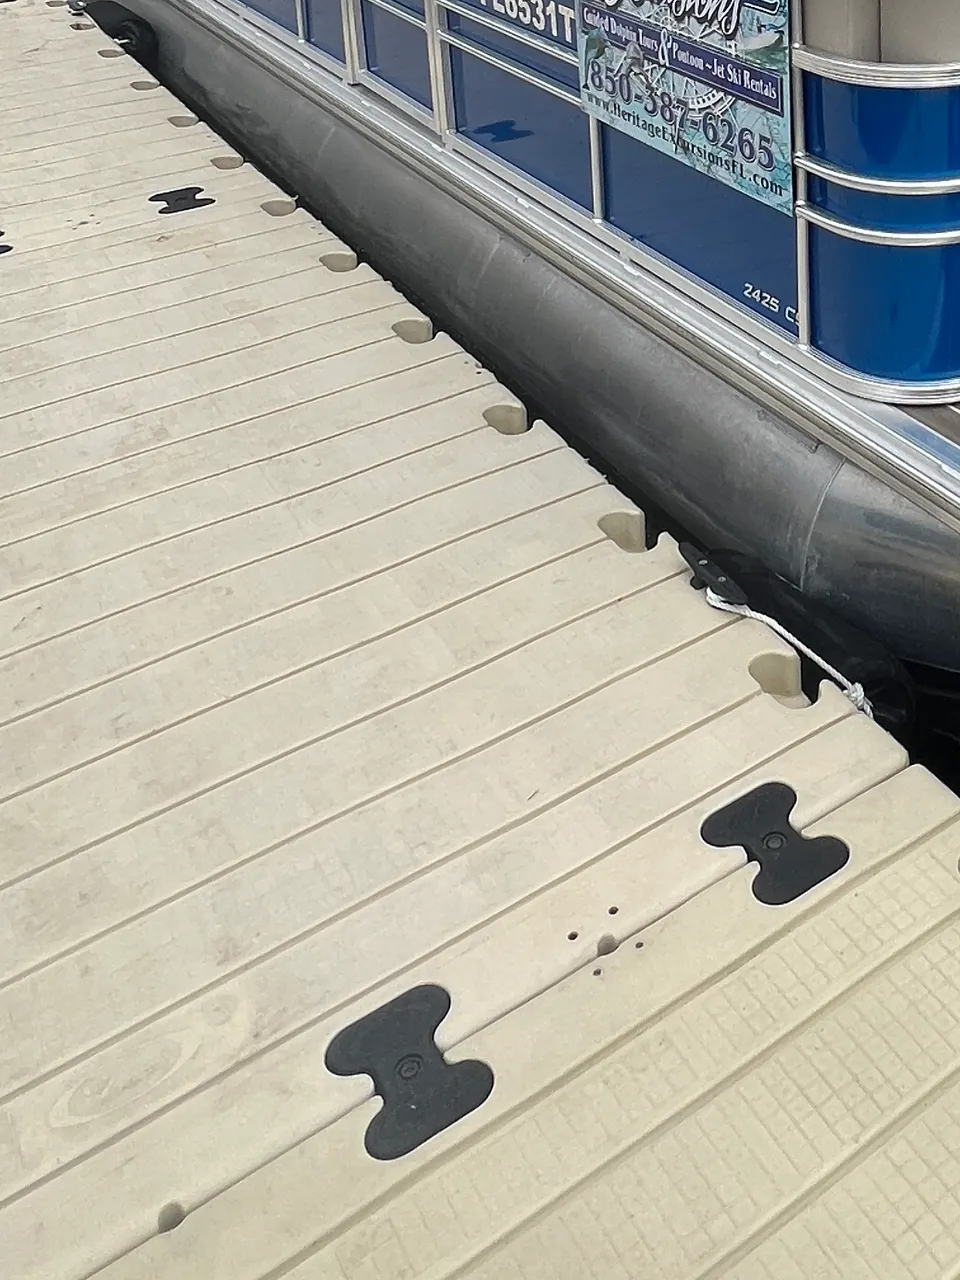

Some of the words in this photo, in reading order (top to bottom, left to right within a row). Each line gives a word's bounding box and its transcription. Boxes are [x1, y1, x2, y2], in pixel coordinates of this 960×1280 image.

[583, 6, 609, 32] Guided
[610, 17, 637, 42] Dolphin
[638, 28, 658, 52] Tours
[658, 28, 673, 66] &
[673, 41, 704, 70] Pontoon
[727, 64, 741, 86] Ski
[743, 70, 777, 100] Rentals
[590, 59, 776, 172] 850-387-6265
[743, 282, 779, 313] 2425
